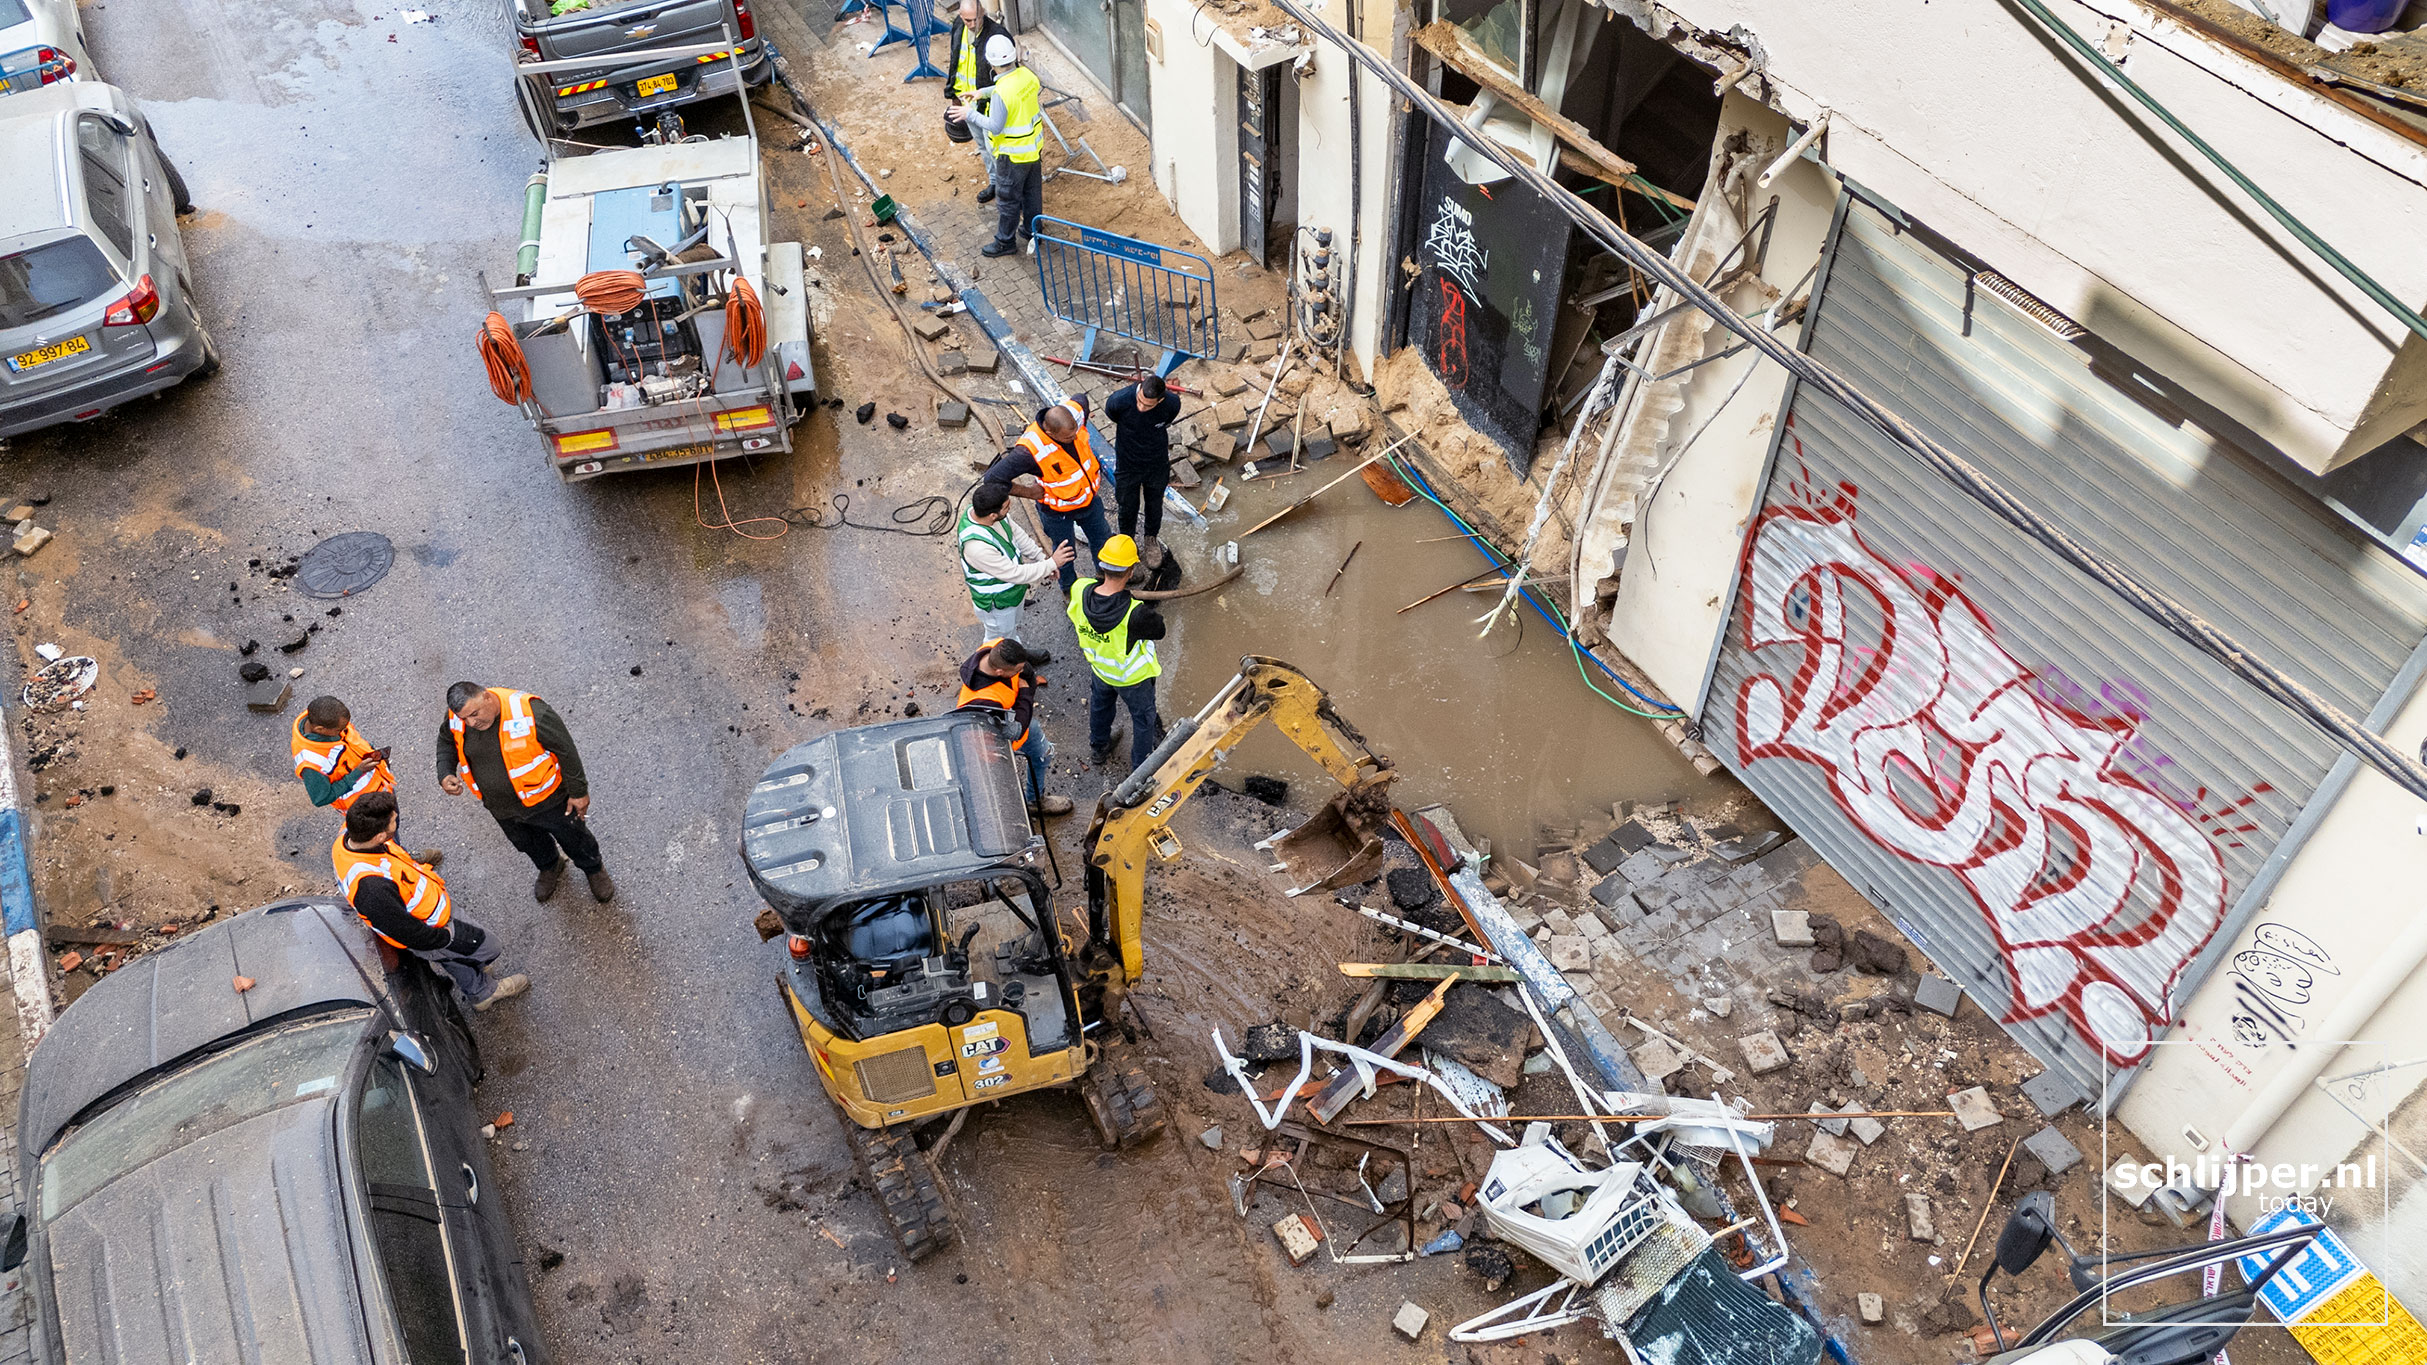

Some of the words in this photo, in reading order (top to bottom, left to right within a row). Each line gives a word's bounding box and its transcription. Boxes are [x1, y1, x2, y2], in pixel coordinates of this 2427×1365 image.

[1444, 195, 1473, 227] SUMO
[1146, 794, 1175, 818] CAT
[961, 1037, 999, 1058] CAT
[974, 1075, 1005, 1089] 302
